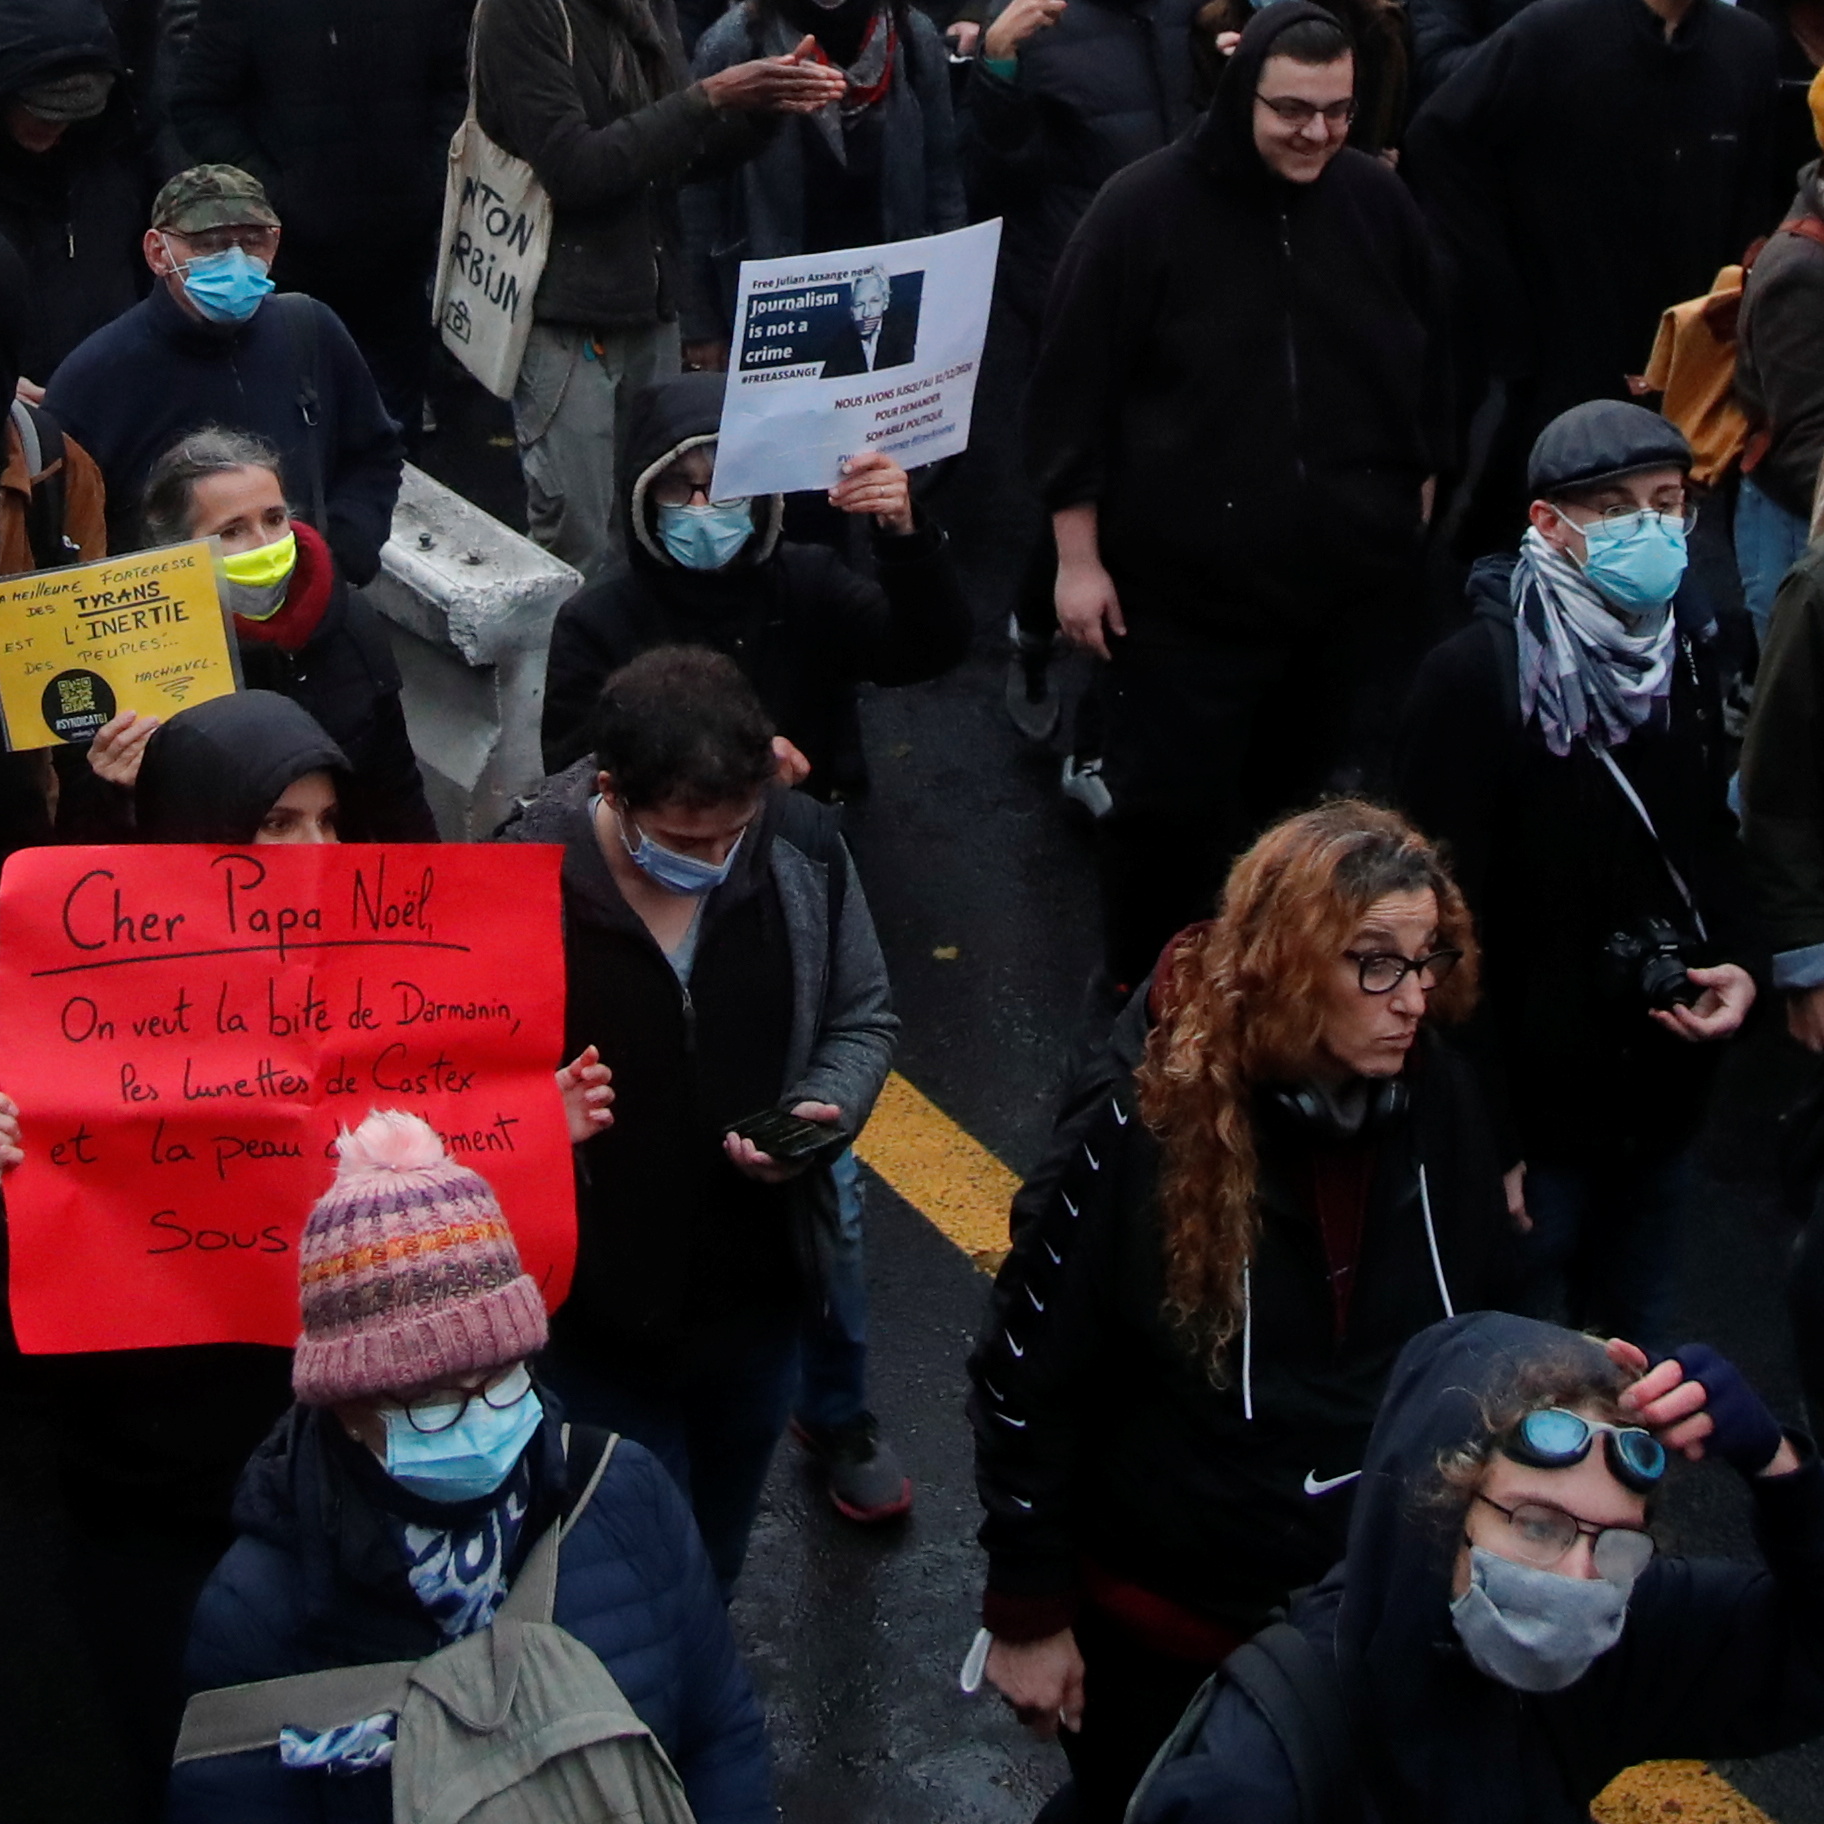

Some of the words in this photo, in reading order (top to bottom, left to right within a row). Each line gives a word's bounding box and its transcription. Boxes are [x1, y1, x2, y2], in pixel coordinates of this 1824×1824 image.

[752, 278, 774, 290] Free
[776, 274, 805, 289] Julian
[807, 270, 849, 283] Assange
[749, 290, 839, 318] Journalism
[748, 323, 763, 339] is
[766, 322, 795, 338] not
[797, 319, 809, 334] a
[744, 345, 794, 364] crime
[741, 367, 818, 385] #FREEASSANGE
[834, 395, 864, 410] NOUS
[864, 389, 895, 405] AVONS
[874, 405, 899, 422] POUR
[99, 556, 196, 586] FORTERESSE
[25, 604, 56, 618] DES
[74, 581, 161, 611] TYRANS
[4, 638, 35, 654] EST
[64, 601, 190, 646] L'INERTIE
[24, 661, 54, 675] DES
[62, 869, 186, 951] Cher
[210, 853, 322, 963] Papa
[61, 996, 115, 1043] On
[132, 982, 192, 1036] veut
[215, 981, 249, 1035] la
[268, 975, 333, 1038] bite
[348, 976, 382, 1030] de
[392, 980, 522, 1038] Darmanin,
[183, 1057, 311, 1102] lunettes
[325, 1056, 357, 1096] de
[370, 1043, 476, 1096] Castex
[50, 1129, 99, 1165] et
[150, 1116, 195, 1165] la
[214, 1134, 302, 1179] peau
[146, 1209, 289, 1255] Sous
